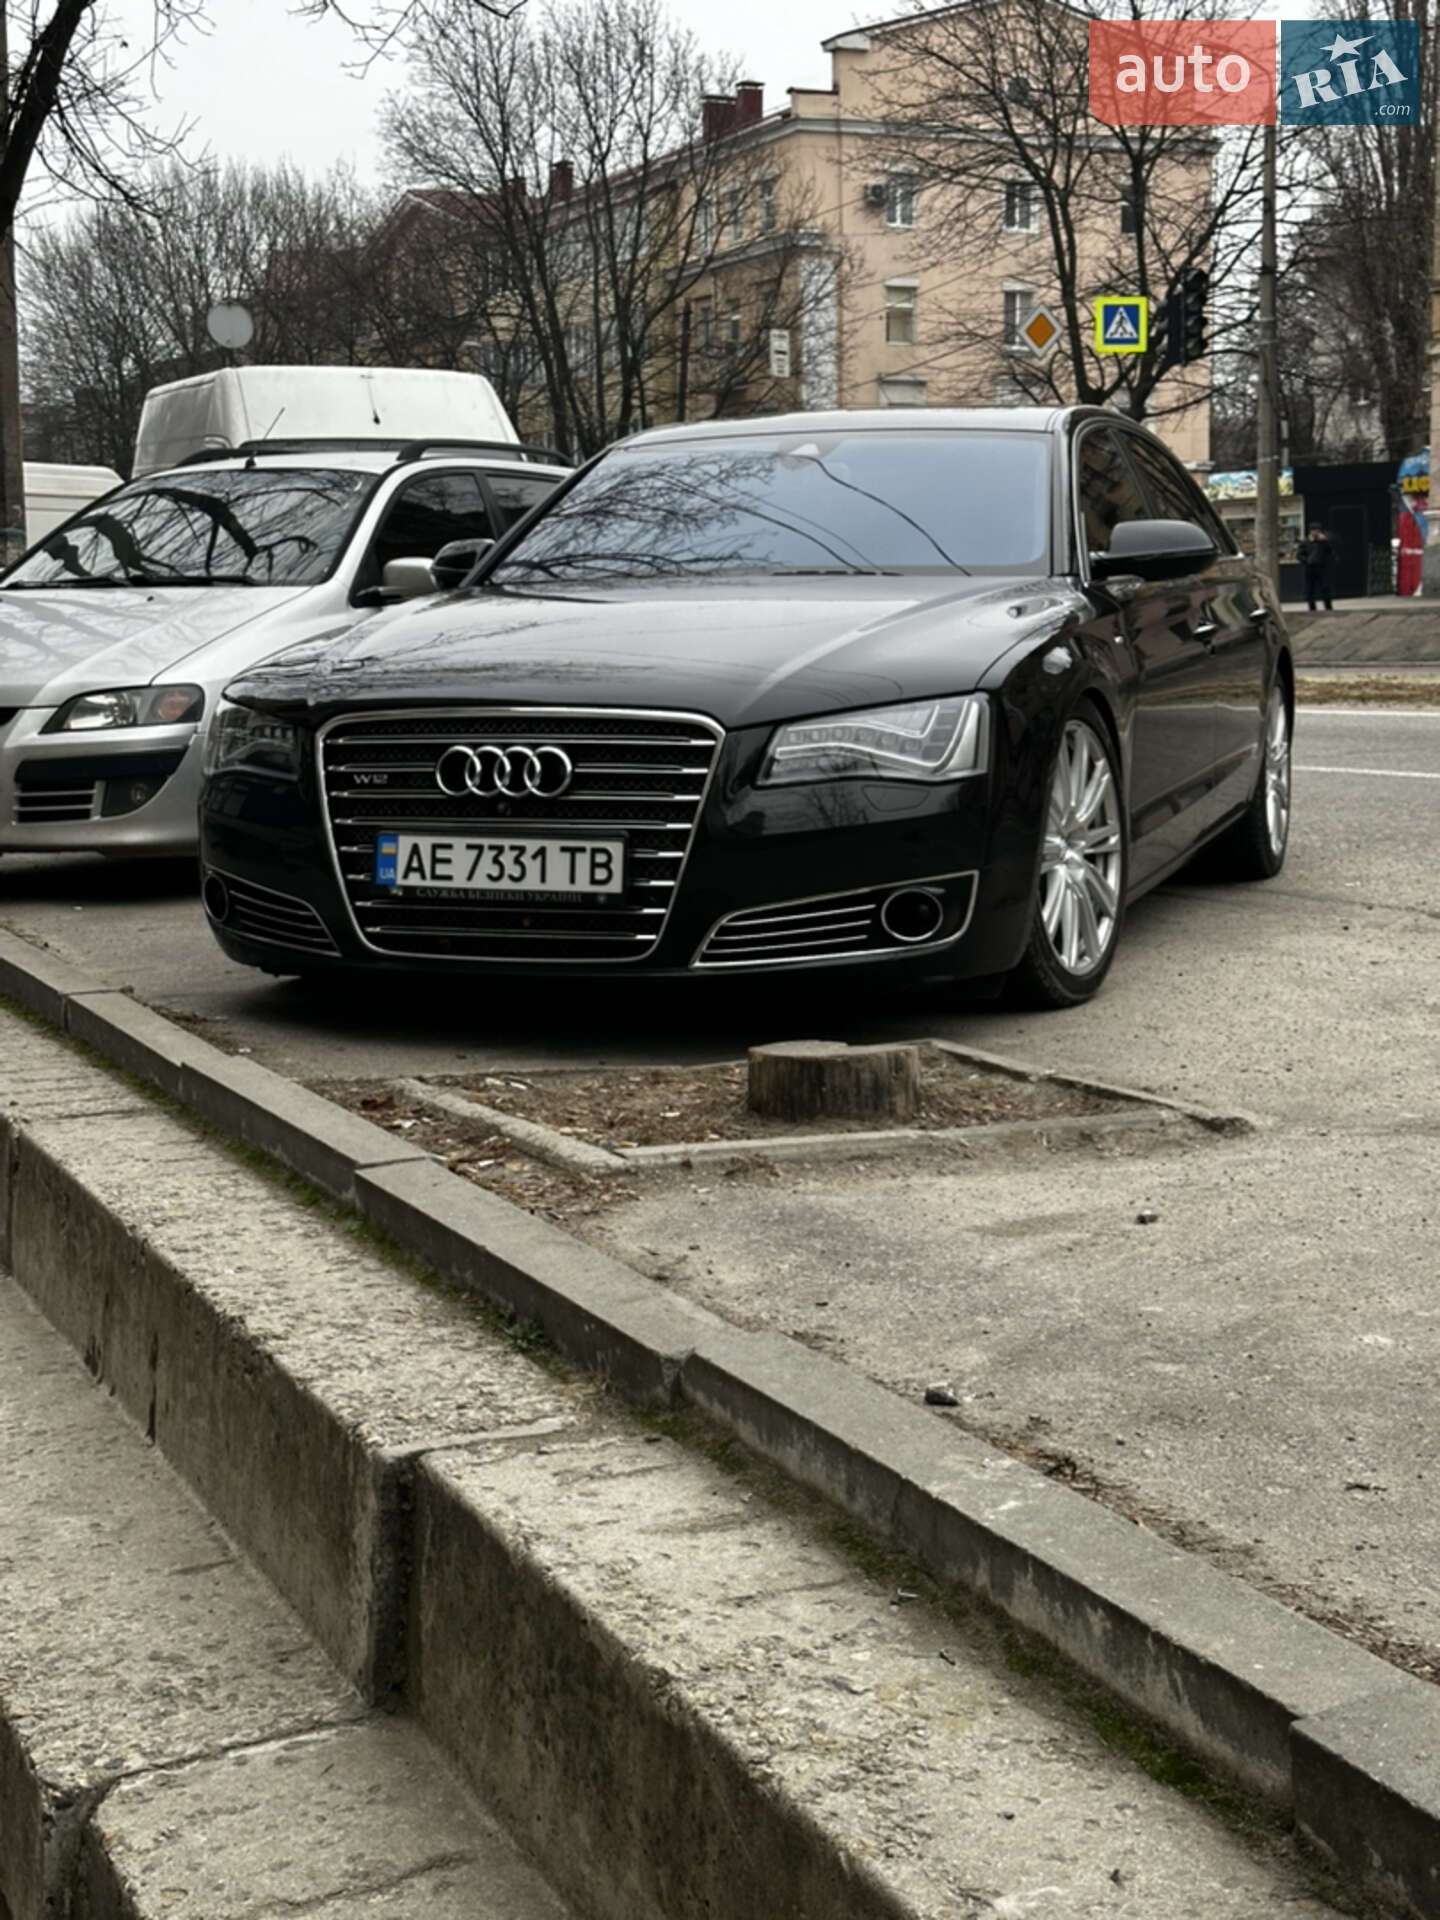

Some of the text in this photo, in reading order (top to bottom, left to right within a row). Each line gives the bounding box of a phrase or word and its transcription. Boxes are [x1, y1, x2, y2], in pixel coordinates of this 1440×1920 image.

[379, 867, 396, 880] UA
[402, 842, 614, 886] AE 7331 TB
